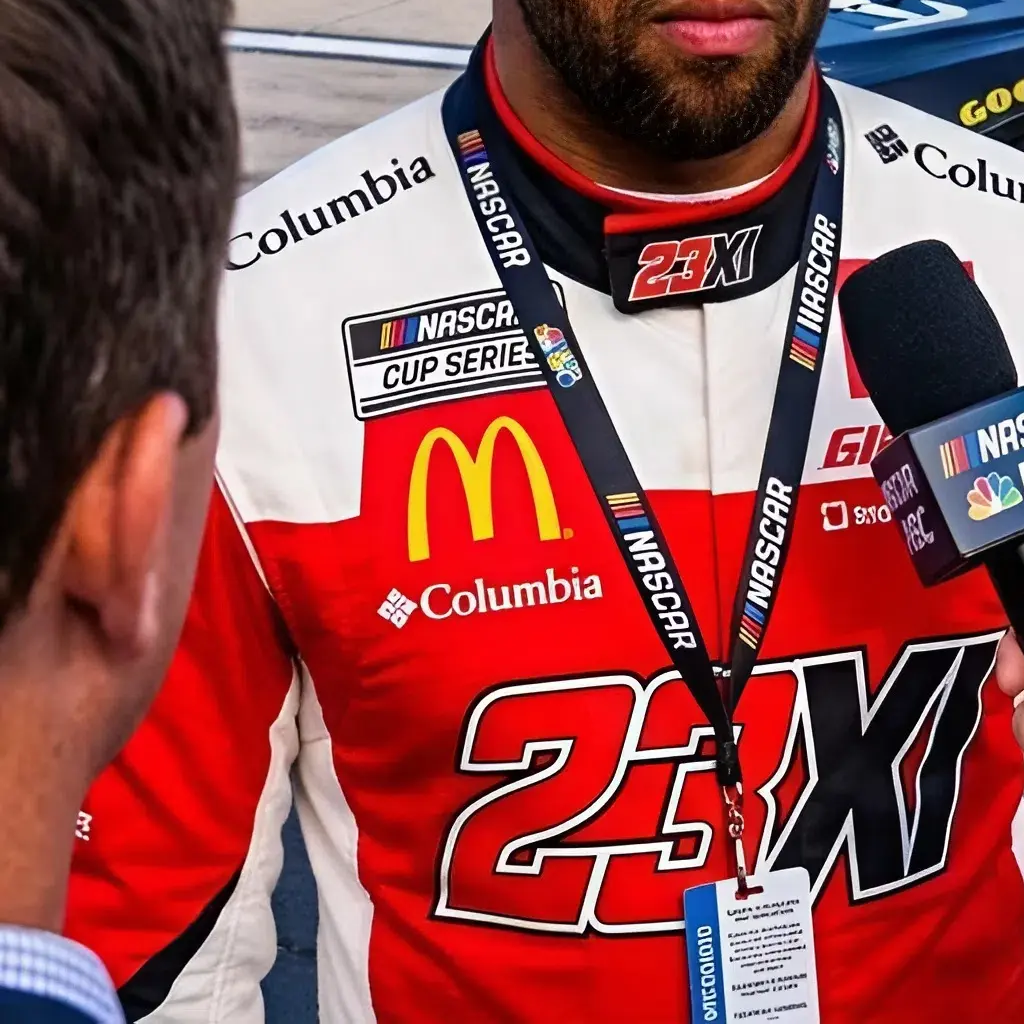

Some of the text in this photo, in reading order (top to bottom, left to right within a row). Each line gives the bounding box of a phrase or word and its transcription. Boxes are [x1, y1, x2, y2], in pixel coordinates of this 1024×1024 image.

[226, 155, 437, 271] Columbia
[467, 161, 531, 269] NASCAR
[628, 225, 764, 302] 23XI
[417, 299, 520, 343] NASCA
[383, 356, 439, 390] CUP
[746, 476, 793, 609] NASCAR
[419, 566, 604, 621] Columbia
[623, 530, 697, 650] NASCAR
